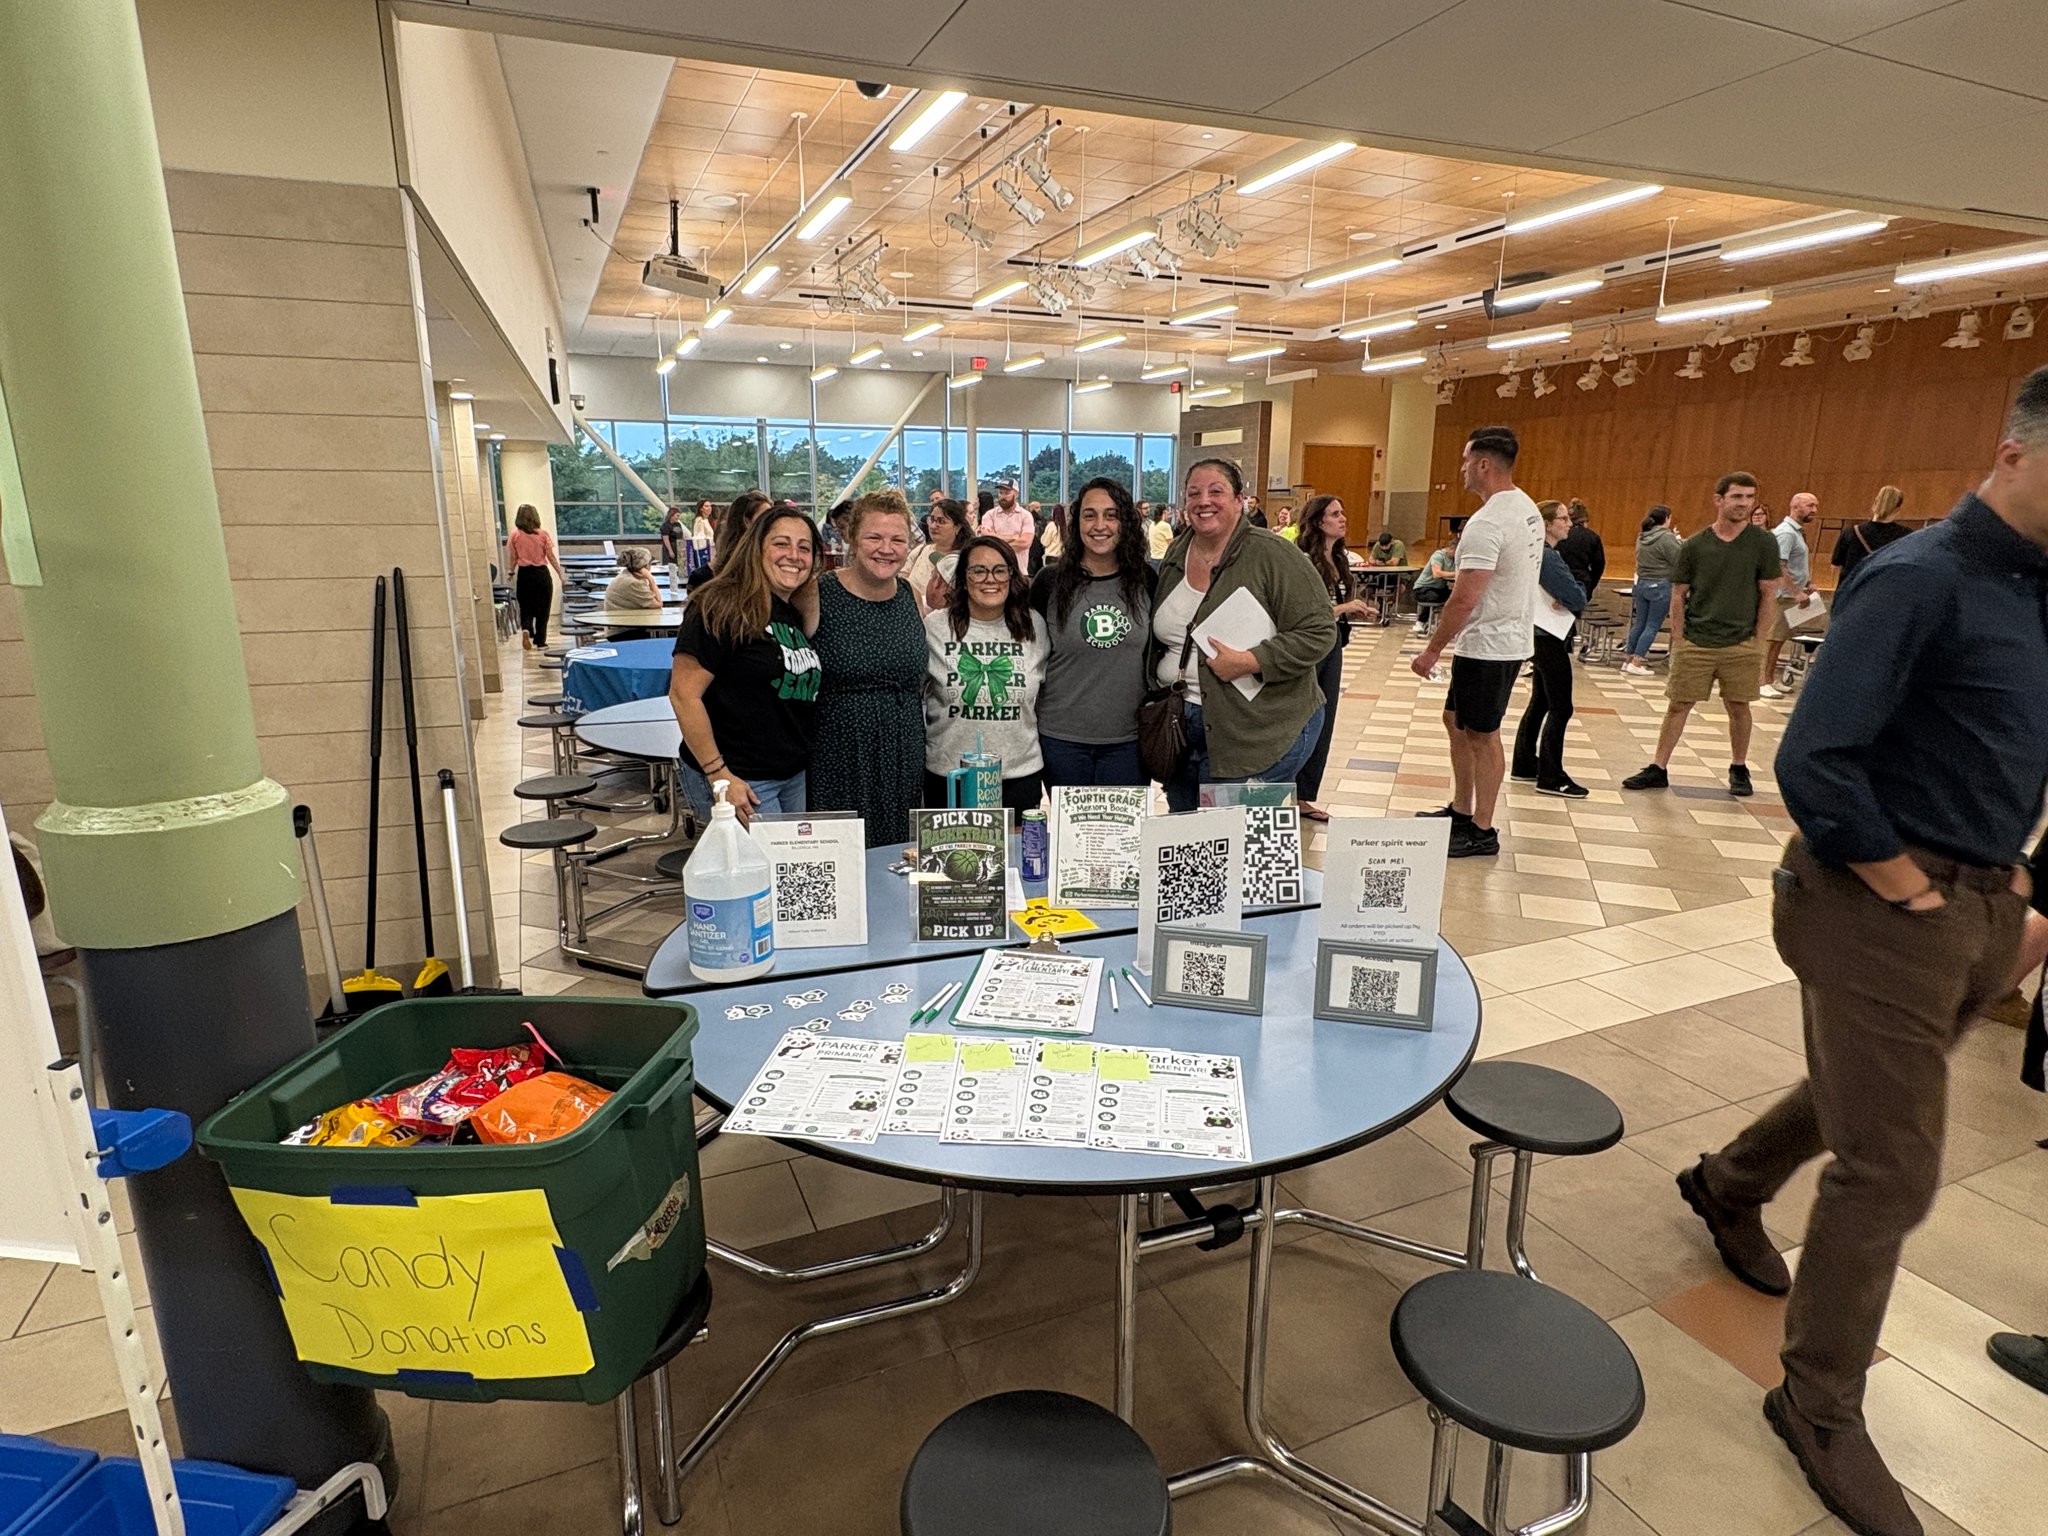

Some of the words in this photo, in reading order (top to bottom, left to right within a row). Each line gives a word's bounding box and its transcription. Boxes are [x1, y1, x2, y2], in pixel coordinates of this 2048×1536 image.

[1084, 605, 1122, 617] PARKER
[1093, 615, 1115, 637] B
[944, 642, 1024, 656] PARKER
[1086, 636, 1125, 649] SCHOOL
[948, 705, 1021, 720] PARKER
[1065, 793, 1106, 807] FOURTH
[1108, 793, 1141, 808] GRADE
[1076, 804, 1107, 814] Memory
[1110, 804, 1128, 813] Book
[932, 811, 969, 829] PICK
[972, 812, 993, 827] UP
[921, 826, 1005, 850] BASKETBALL
[1350, 839, 1379, 847] Parker
[1380, 839, 1404, 848] spirit
[693, 922, 717, 931] HAND
[932, 924, 969, 937] PICK
[974, 923, 995, 937] UP
[816, 1050, 874, 1059] PRIMARIA!
[268, 1212, 485, 1323] Candy
[320, 1302, 547, 1360] Donations
